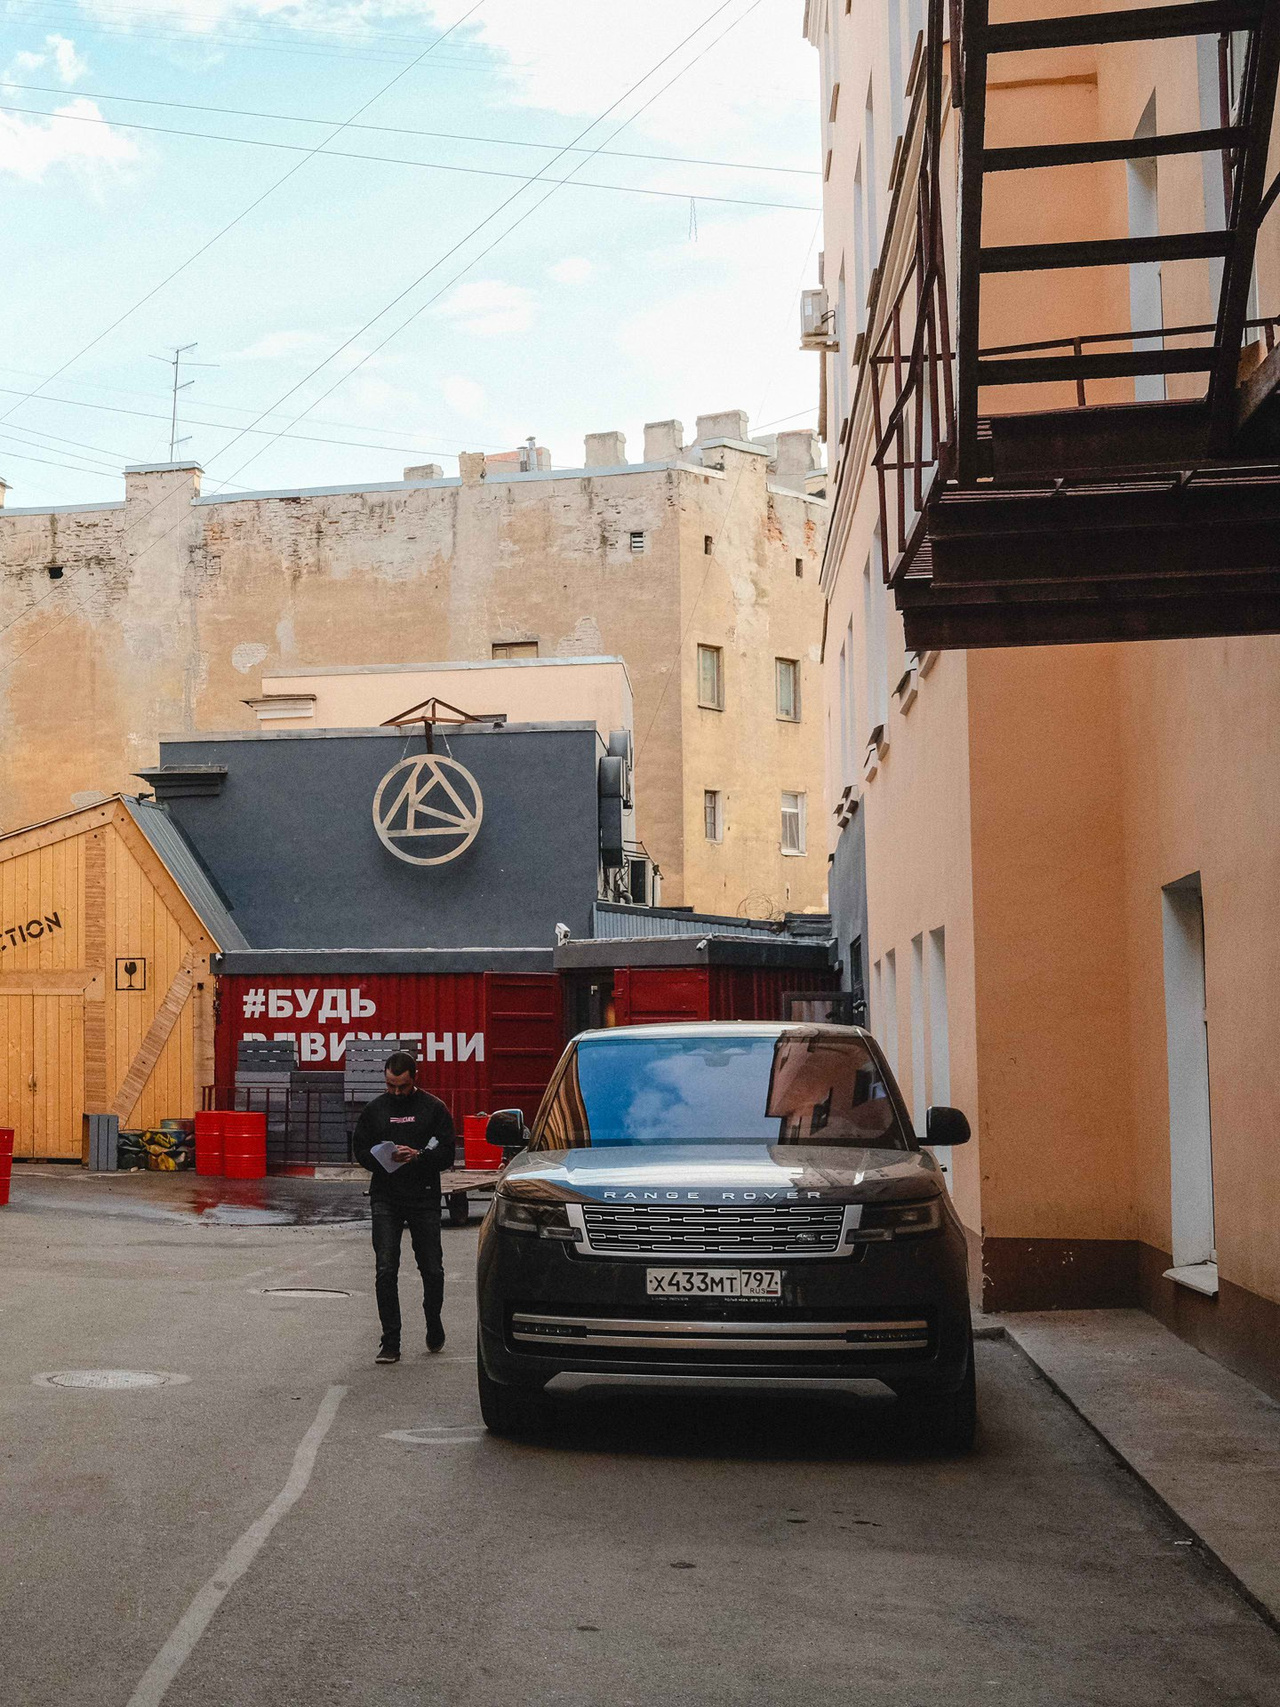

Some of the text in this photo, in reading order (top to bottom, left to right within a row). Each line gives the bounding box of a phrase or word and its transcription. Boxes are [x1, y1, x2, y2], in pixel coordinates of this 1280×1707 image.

[242, 988, 376, 1024] #БУДЬ
[604, 1191, 821, 1200] RANGE ROVER
[741, 1271, 776, 1288] 797
[749, 1287, 766, 1295] RUS
